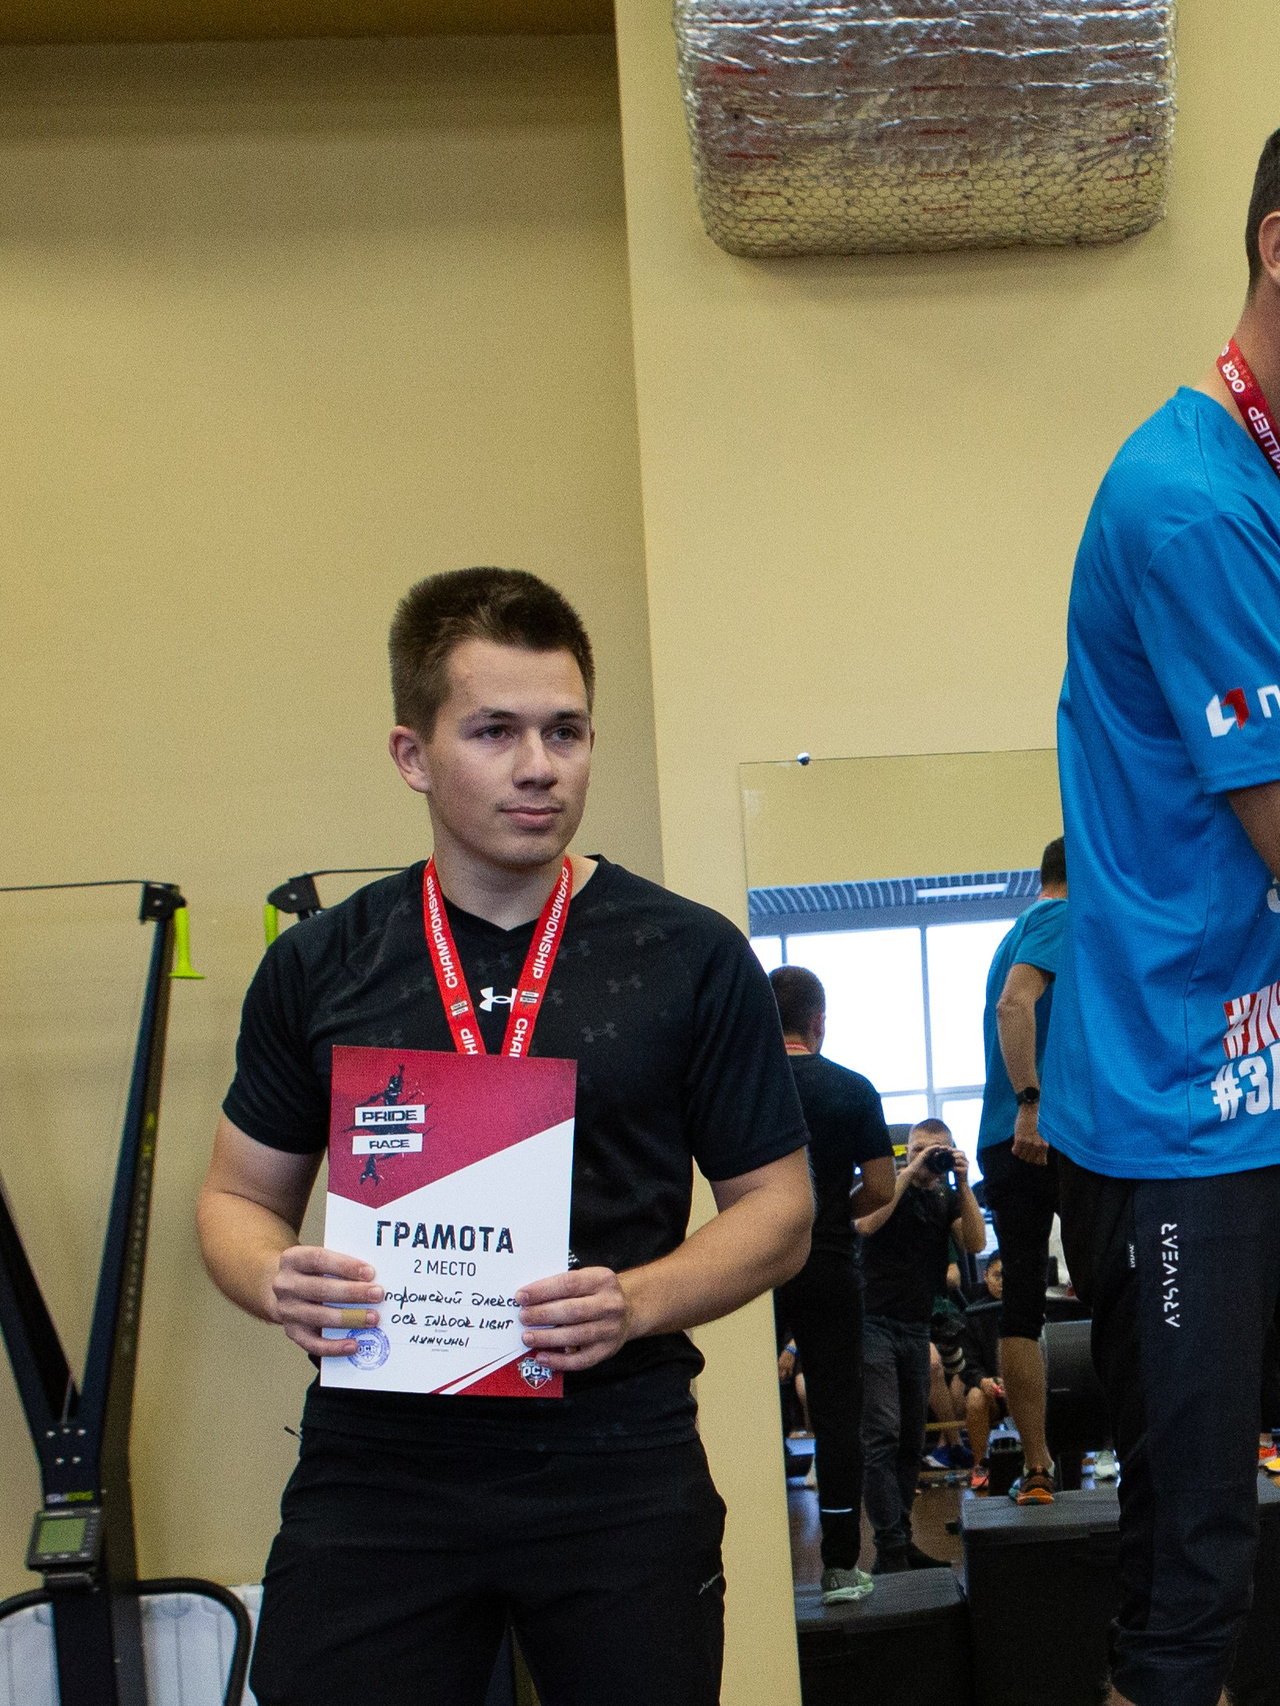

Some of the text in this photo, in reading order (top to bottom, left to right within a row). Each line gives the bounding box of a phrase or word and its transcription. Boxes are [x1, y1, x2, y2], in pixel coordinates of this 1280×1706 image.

[1222, 360, 1246, 393] OCR
[426, 875, 458, 989] CHAMPIONSHIP
[532, 866, 569, 980] CHAMPIONSHIP
[362, 1109, 418, 1123] PRIDE
[368, 1139, 411, 1150] RACE
[376, 1220, 515, 1254] ГРАМОТА
[413, 1259, 477, 1277] 2 МЕСТО
[391, 1312, 417, 1325] OCR
[479, 1318, 514, 1329] LIGHT
[522, 1365, 551, 1380] OCR
